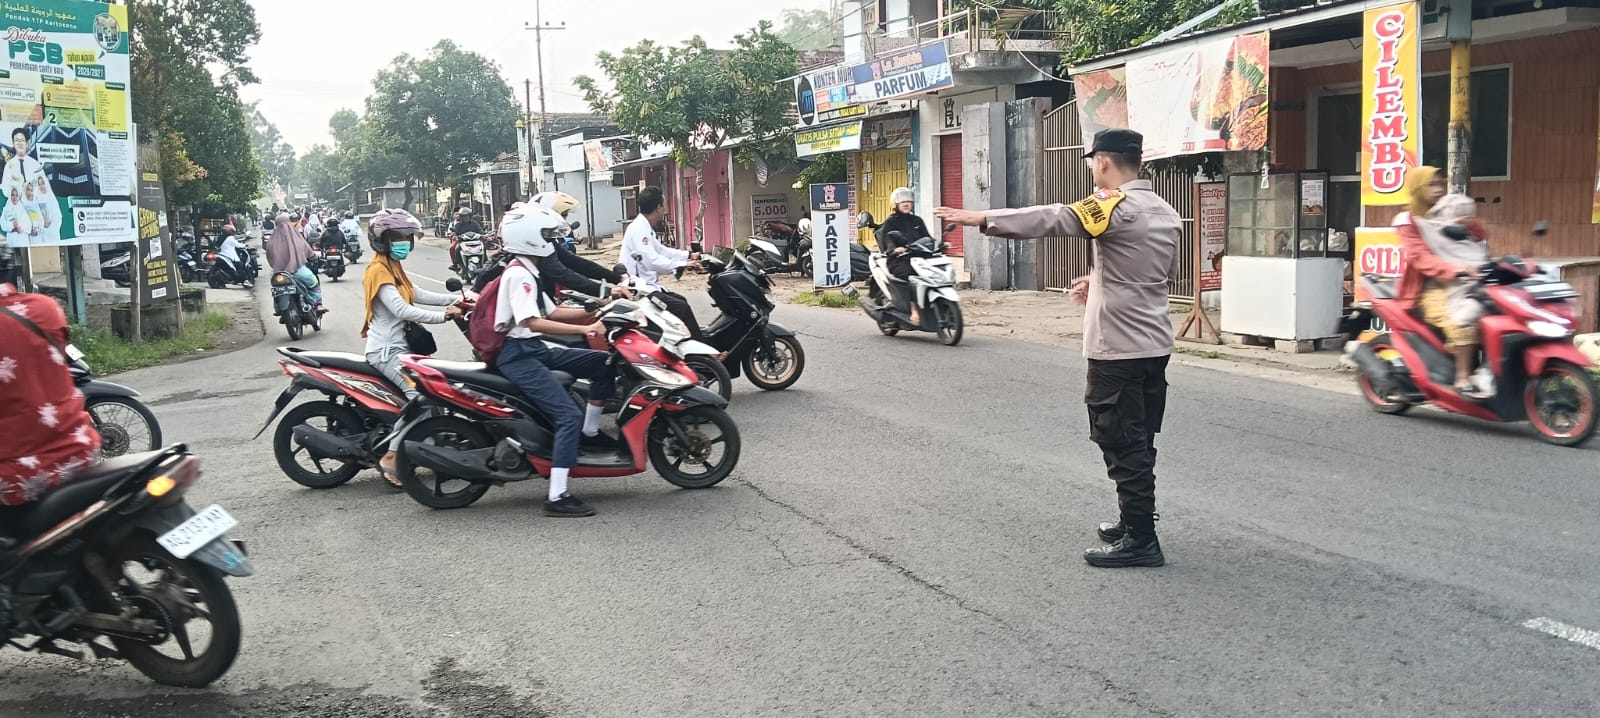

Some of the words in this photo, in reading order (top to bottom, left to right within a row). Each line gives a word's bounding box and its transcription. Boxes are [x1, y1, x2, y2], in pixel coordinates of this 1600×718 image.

[2, 26, 46, 42] Dibuka
[8, 40, 63, 65] PSB
[814, 72, 836, 89] KONTER
[874, 71, 928, 98] PARFUM
[1372, 11, 1408, 193] CILEMBU
[48, 113, 56, 124] 2
[754, 205, 787, 216] 5.000
[825, 213, 840, 286] PARFUM
